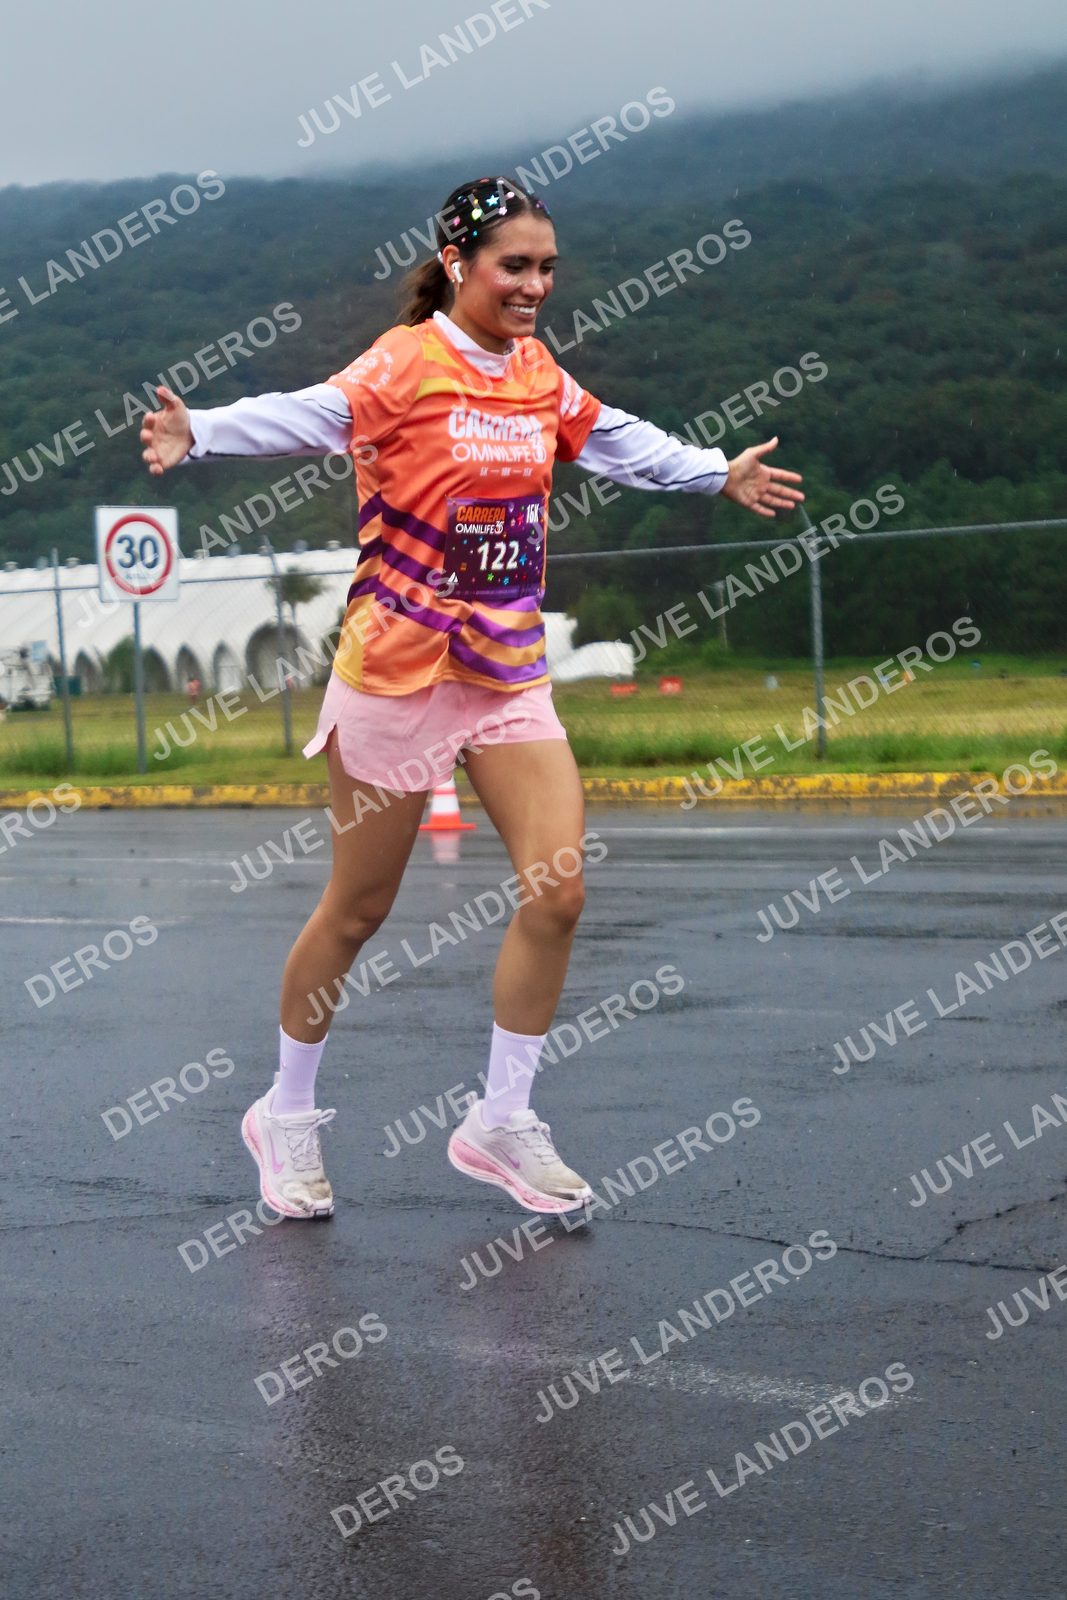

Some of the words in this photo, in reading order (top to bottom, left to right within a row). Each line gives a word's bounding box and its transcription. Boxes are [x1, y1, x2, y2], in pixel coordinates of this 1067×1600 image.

[457, 505, 506, 522] CARRERA
[117, 534, 159, 569] 30
[477, 540, 520, 571] 122
